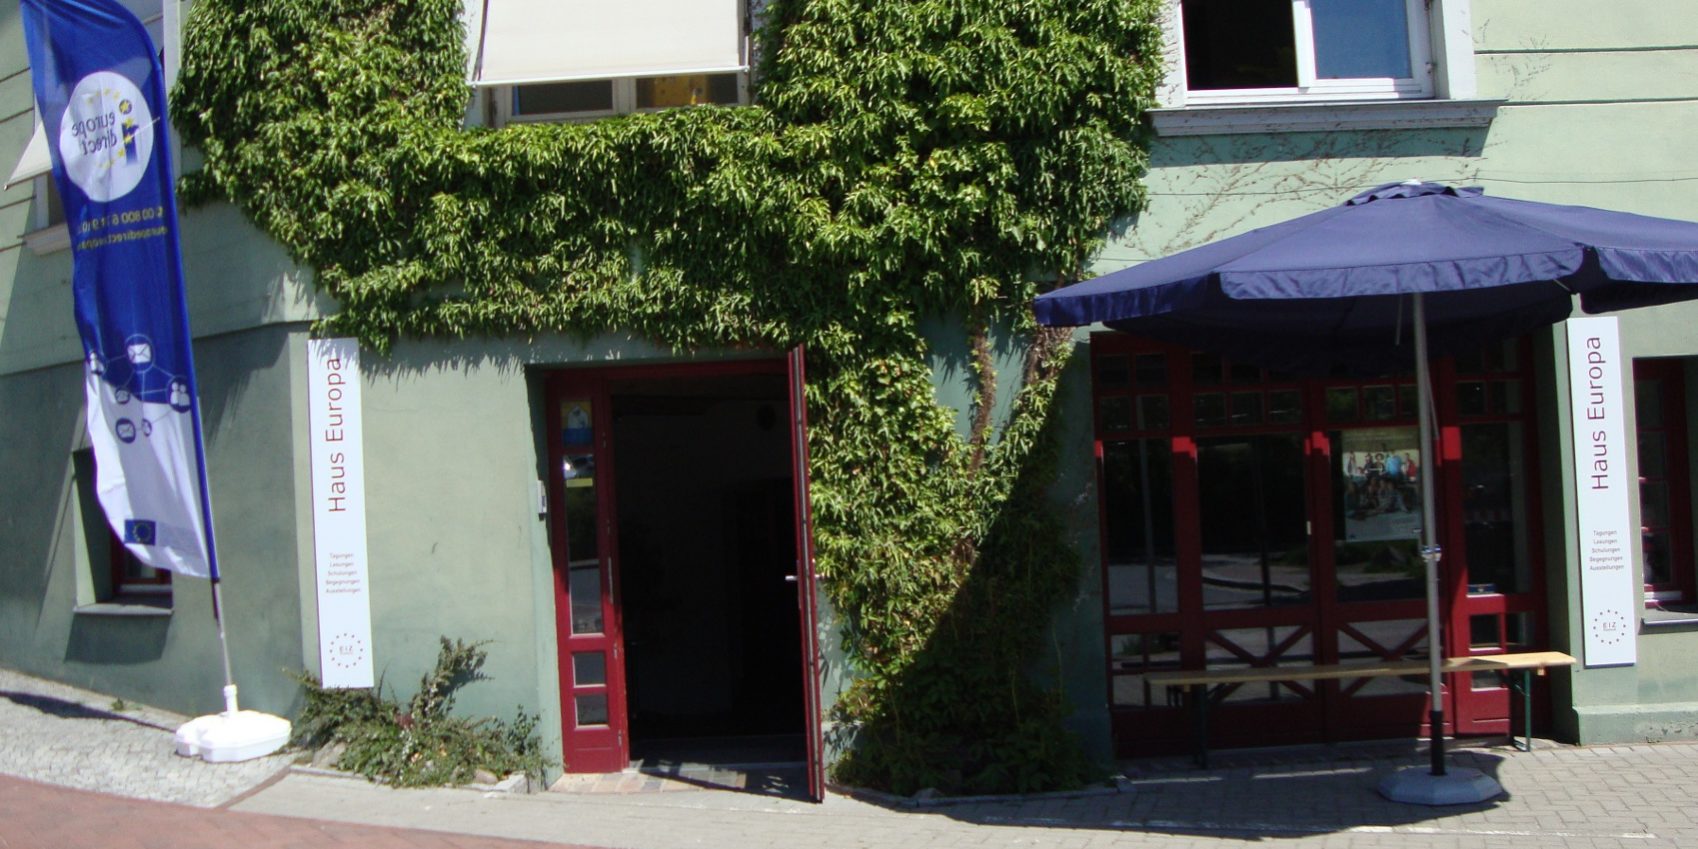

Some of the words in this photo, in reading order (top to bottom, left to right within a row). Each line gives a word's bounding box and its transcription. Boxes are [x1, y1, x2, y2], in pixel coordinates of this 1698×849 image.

[325, 358, 346, 442] Europa
[1586, 337, 1606, 420] Europa
[328, 452, 347, 512] Haus
[1591, 430, 1609, 489] Haus
